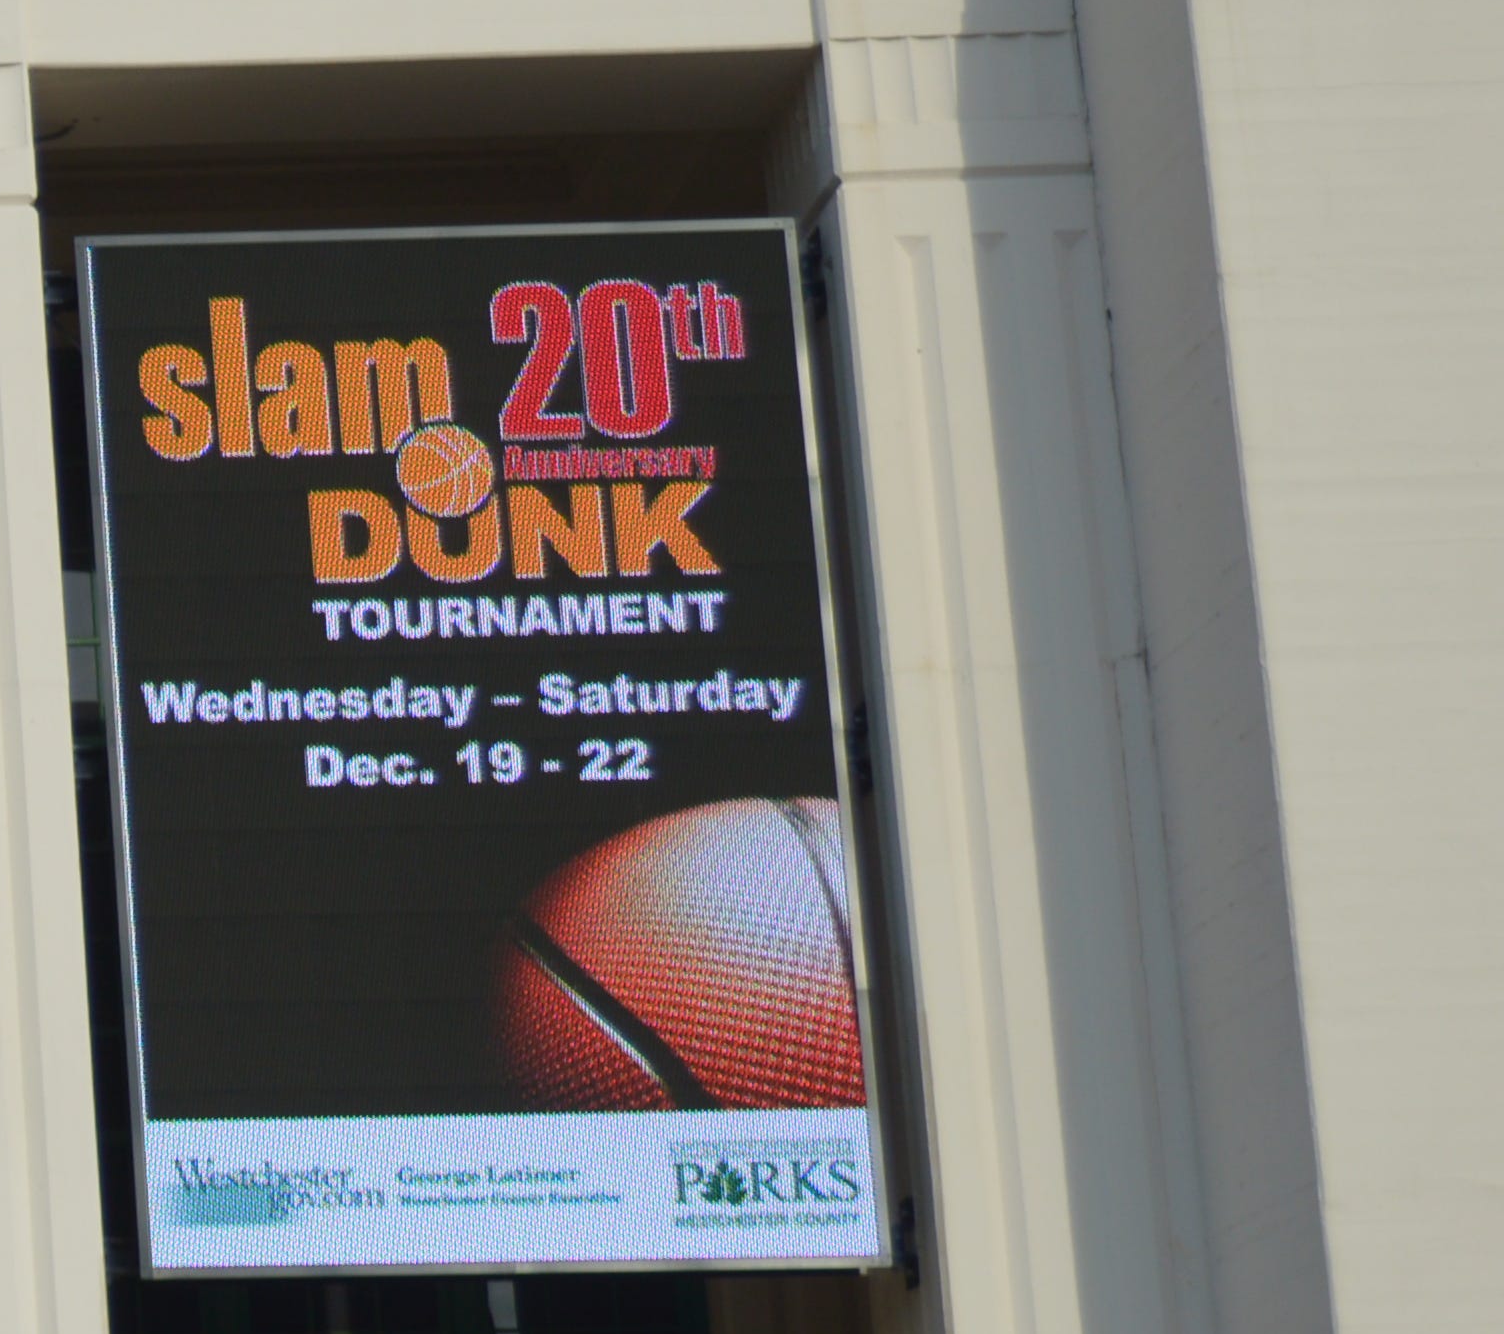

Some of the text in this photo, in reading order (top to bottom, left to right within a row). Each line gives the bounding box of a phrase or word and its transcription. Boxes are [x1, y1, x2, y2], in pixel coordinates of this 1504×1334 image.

[138, 297, 454, 459] slam
[489, 278, 746, 441] 20th
[504, 445, 718, 482] Anniversary
[308, 481, 723, 583] DUNK
[312, 592, 726, 641] TOURNAMENT
[141, 677, 477, 729] Wednesday
[537, 670, 802, 721] Saturday
[304, 746, 436, 788] Dec.
[455, 742, 525, 785] 19
[578, 739, 653, 783] 22
[174, 1156, 354, 1193] Westchester
